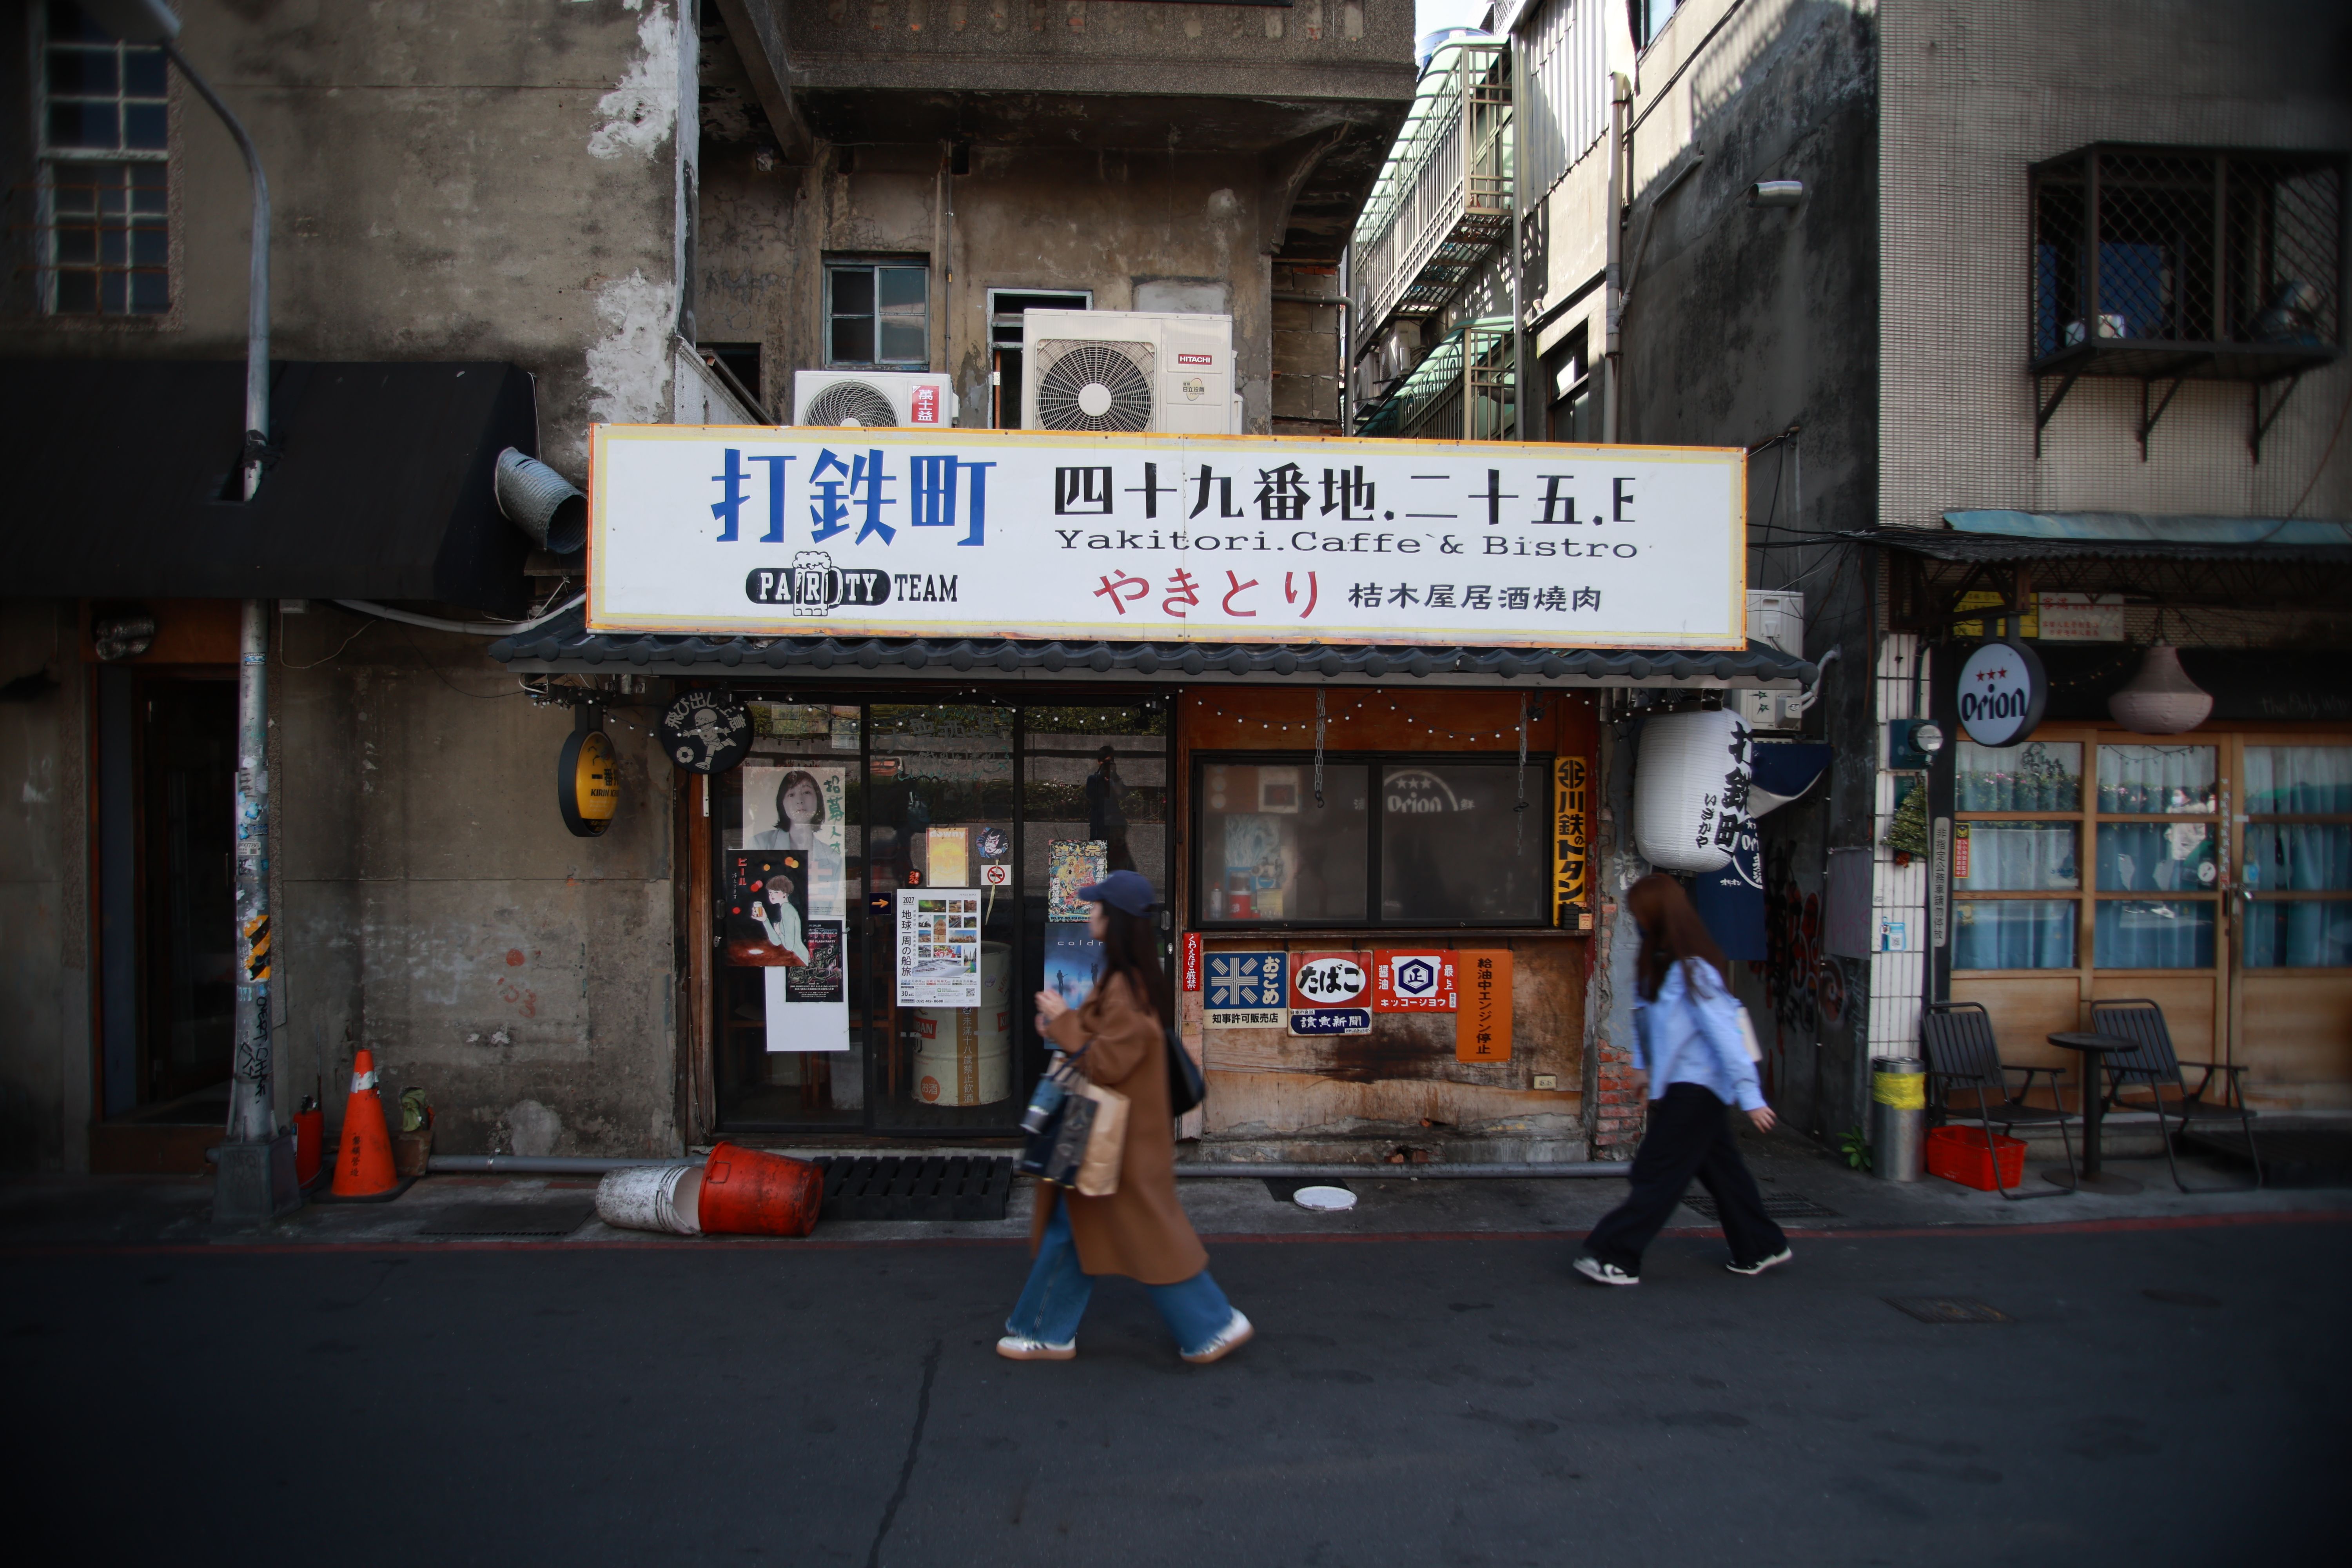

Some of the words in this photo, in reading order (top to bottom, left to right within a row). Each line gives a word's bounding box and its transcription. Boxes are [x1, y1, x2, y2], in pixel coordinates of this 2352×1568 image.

[918, 390, 933, 421] 萬士益
[711, 448, 996, 546] 打鉄町
[1440, 535, 1464, 554] &
[1483, 535, 1637, 559] Bistro
[895, 574, 958, 602] TEAM
[1093, 568, 1318, 619] やきとり
[1962, 684, 2026, 721] Orion
[824, 775, 845, 855] 招募人才
[1388, 792, 1442, 813] Orion
[930, 829, 966, 839] downy
[1558, 791, 1584, 904] 川鉄のトタン
[1054, 844, 1101, 857] 浪人祭
[738, 858, 747, 886] ビール
[901, 909, 912, 976] 地球一周の船旅
[1185, 935, 1197, 989] くわえたばこ厳禁
[1444, 965, 1454, 990] 最上
[1262, 956, 1280, 1004] おこめ
[1298, 964, 1360, 994] たばこ
[1212, 1013, 1278, 1024] 知事許可販売店
[1476, 958, 1493, 1054] 給油中エンジン停止
[963, 1016, 973, 1102] 未滿十八歲禁止飲酒
[922, 1083, 938, 1095] お酒
